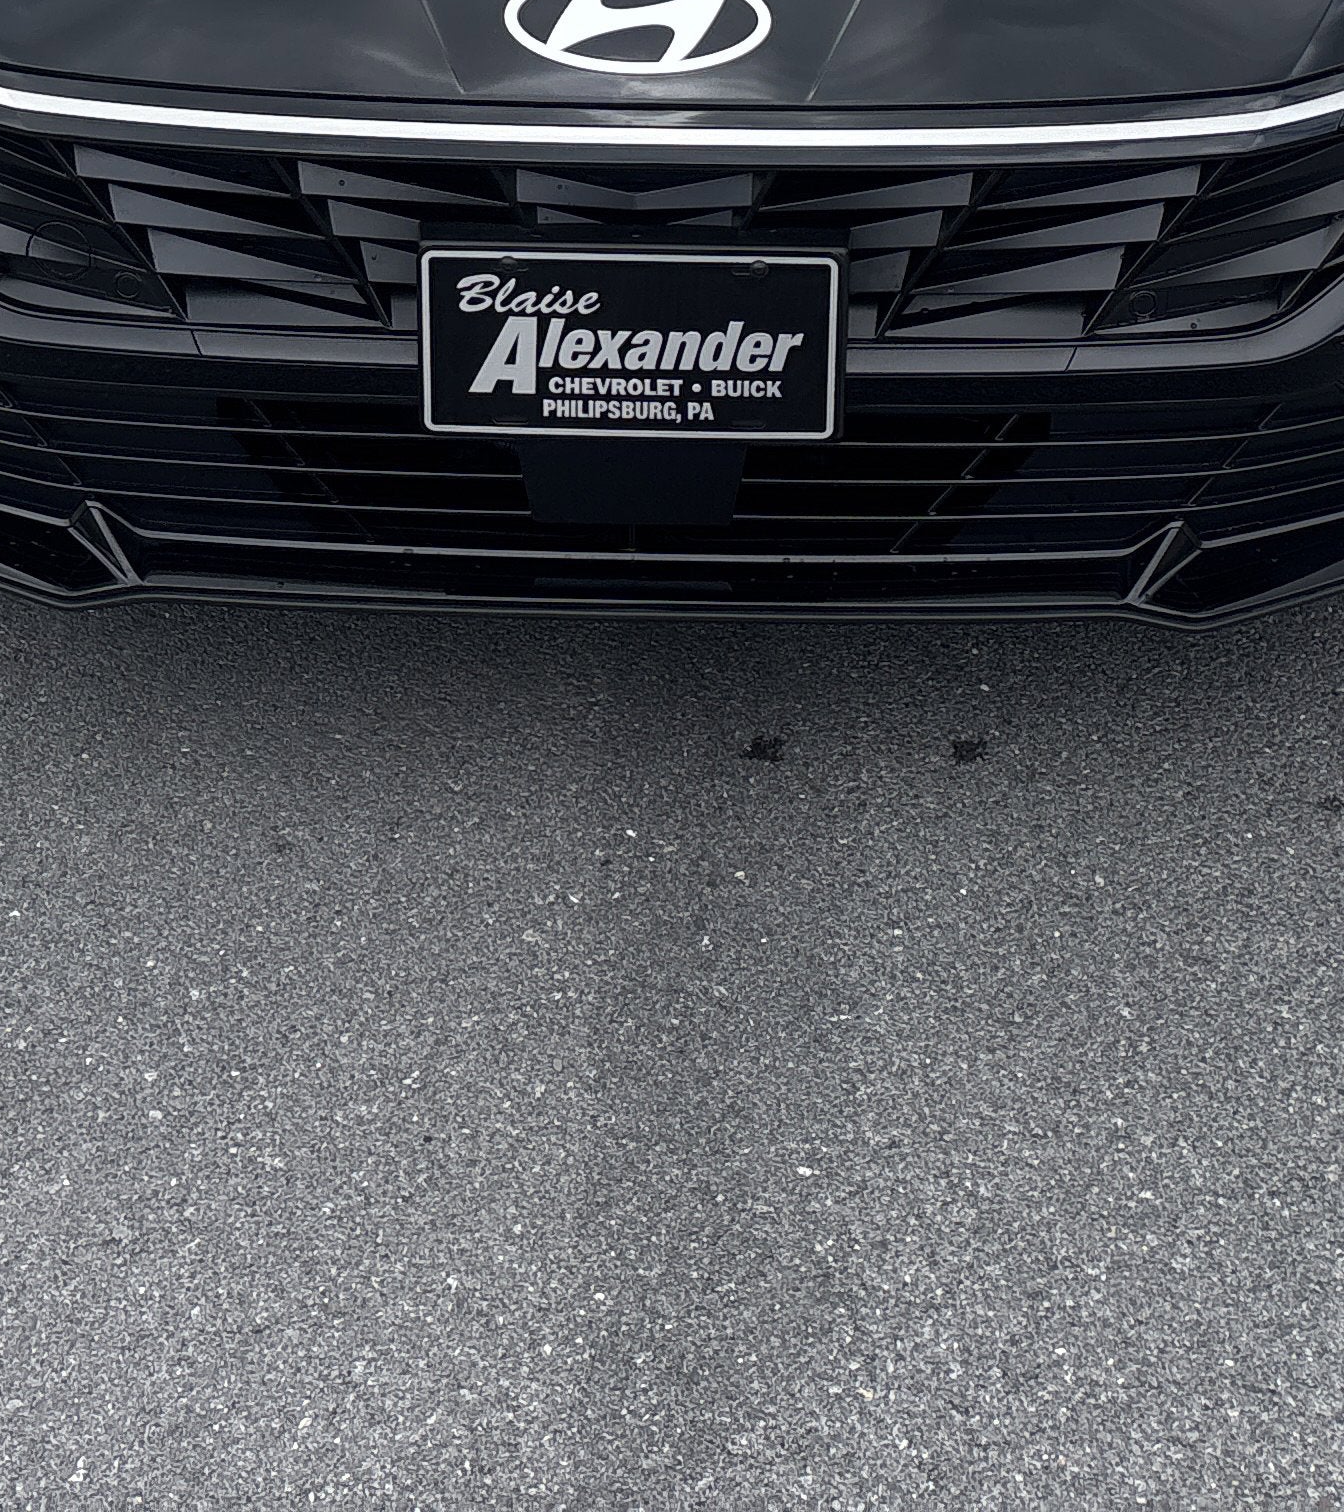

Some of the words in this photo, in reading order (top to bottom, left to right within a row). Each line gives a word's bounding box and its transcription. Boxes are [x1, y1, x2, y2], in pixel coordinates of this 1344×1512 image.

[456, 274, 601, 315] Blaise
[468, 316, 805, 395] Alexander
[548, 377, 684, 397] CHEVROLET
[711, 379, 783, 399] BUICK
[542, 400, 682, 424] PHILIPSBURG,
[687, 402, 715, 422] PA
